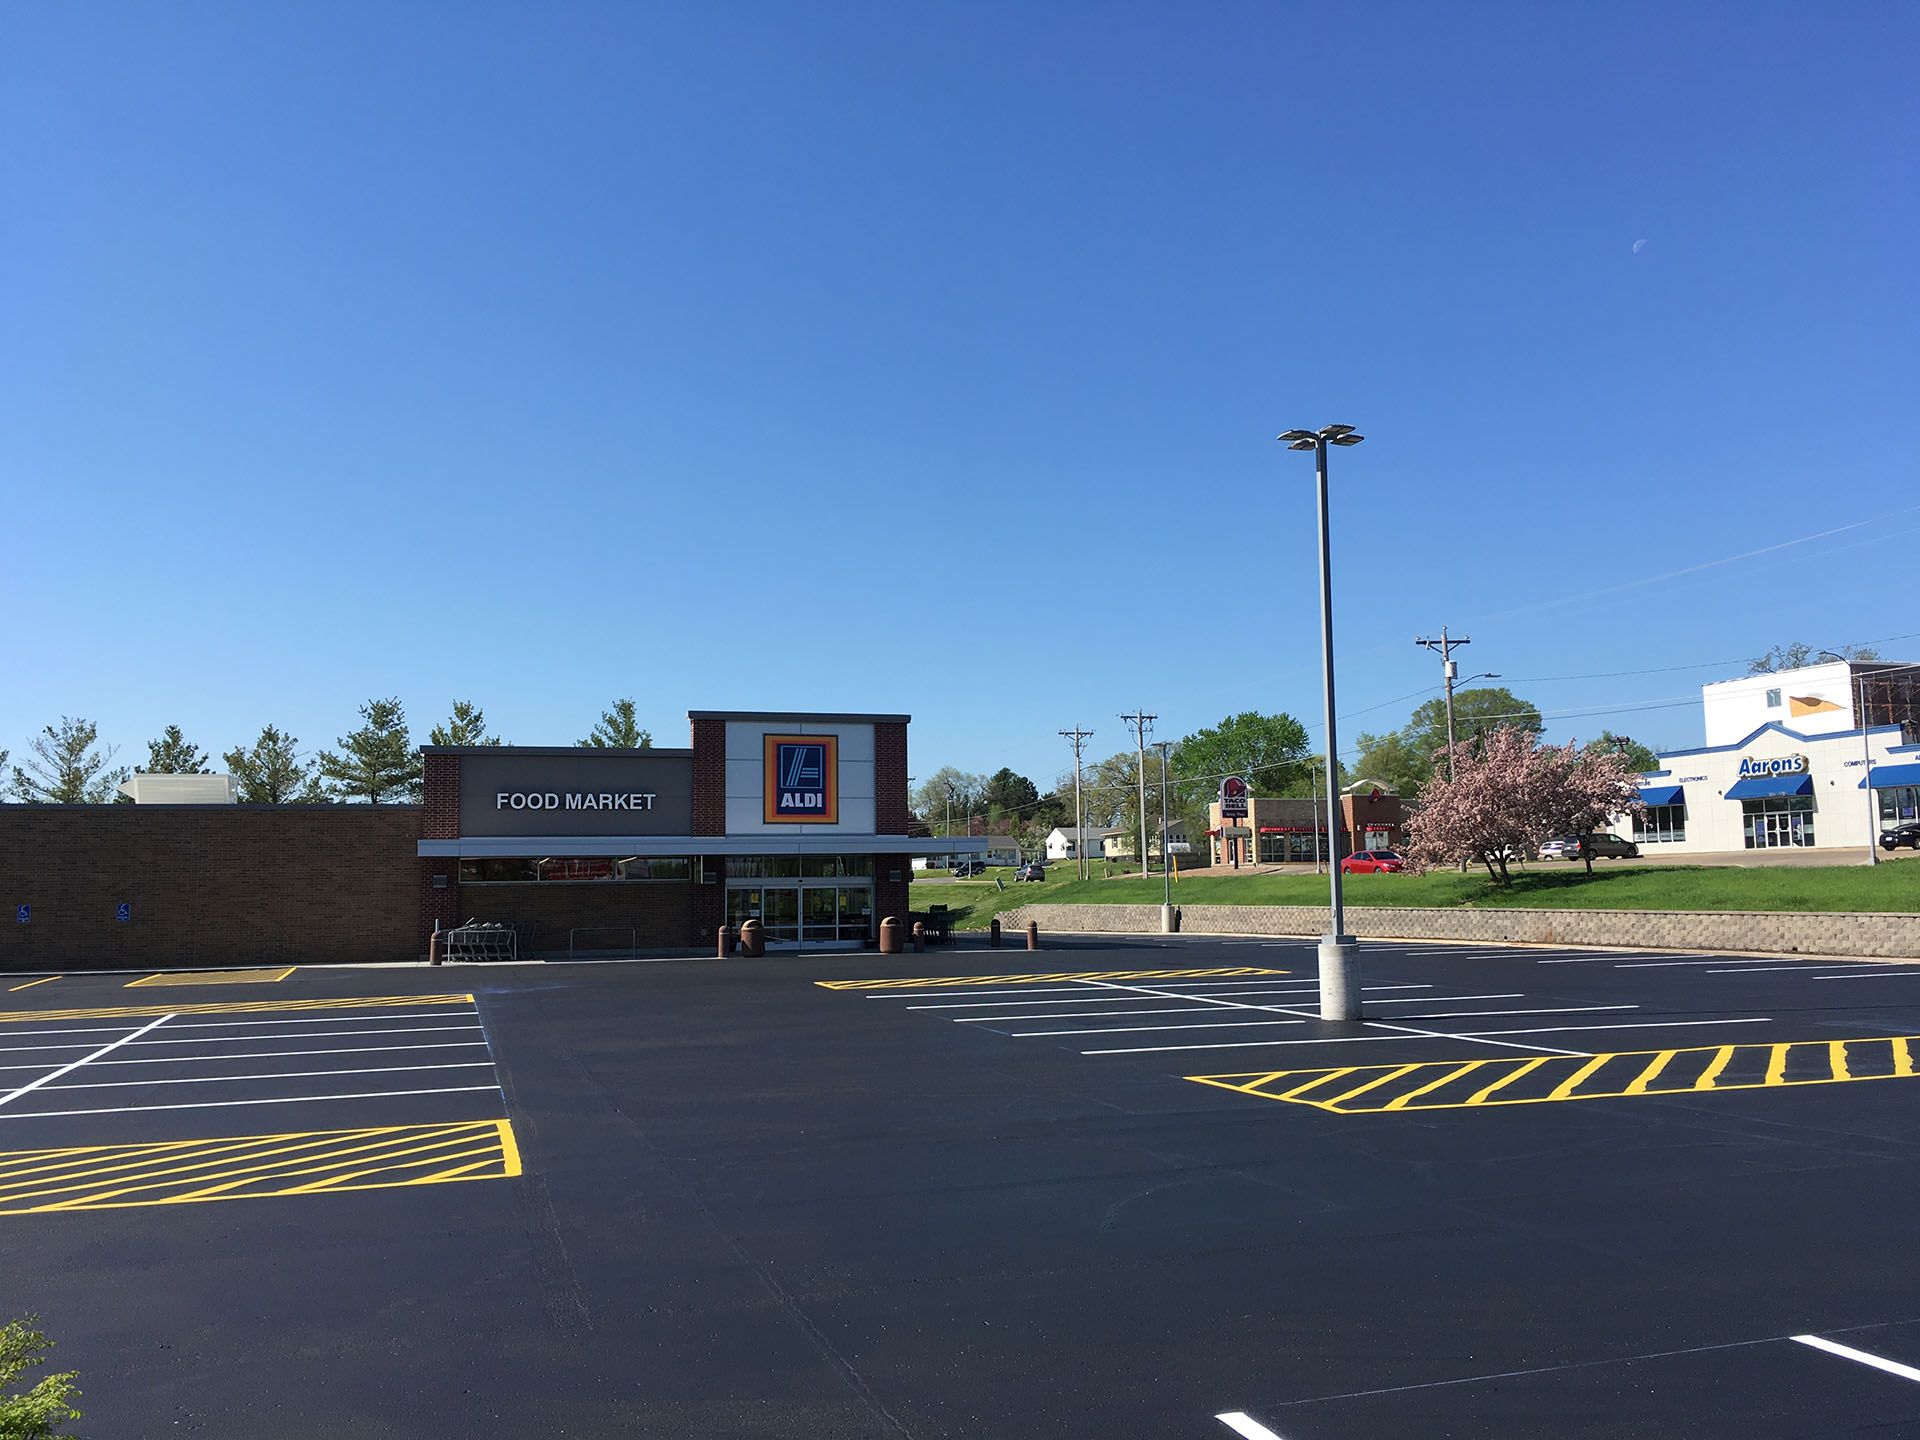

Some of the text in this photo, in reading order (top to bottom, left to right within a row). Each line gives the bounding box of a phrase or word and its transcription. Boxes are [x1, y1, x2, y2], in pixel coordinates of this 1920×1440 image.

[1843, 759, 1877, 768] COMPUTRS
[497, 792, 657, 810] FOOD MARKET
[780, 792, 823, 808] ALDI
